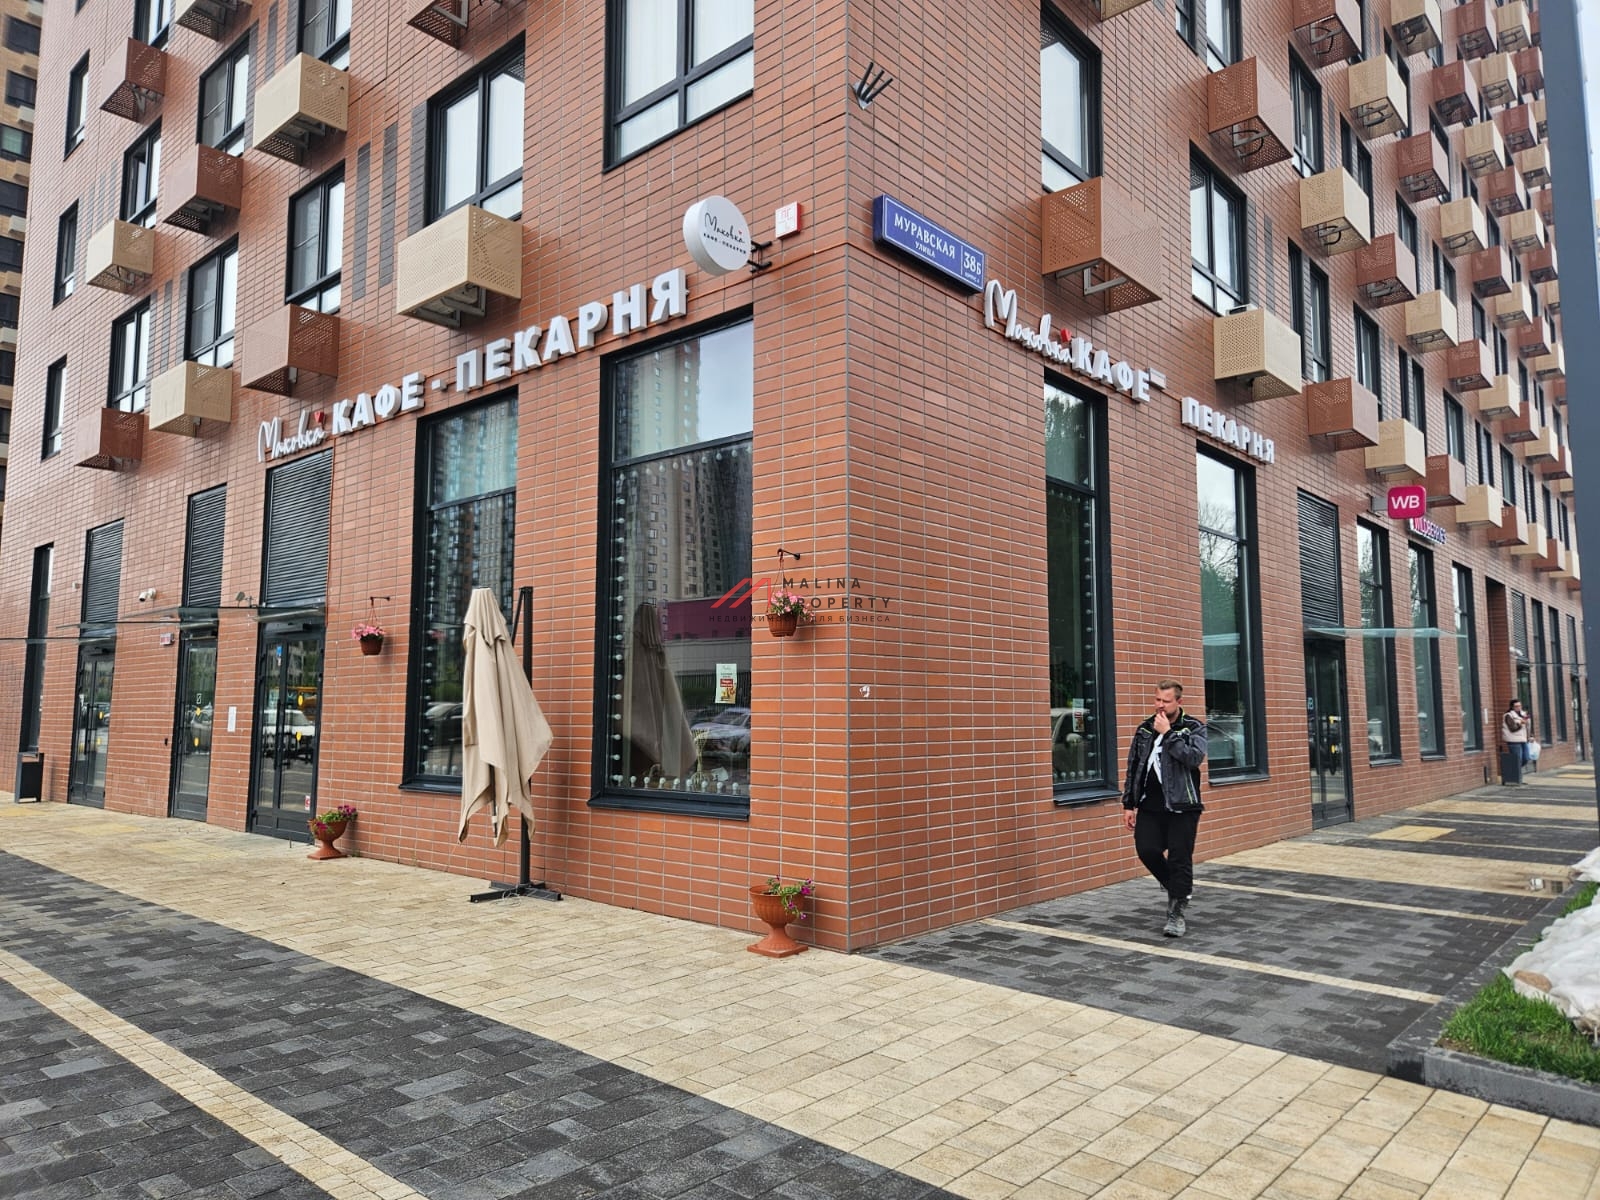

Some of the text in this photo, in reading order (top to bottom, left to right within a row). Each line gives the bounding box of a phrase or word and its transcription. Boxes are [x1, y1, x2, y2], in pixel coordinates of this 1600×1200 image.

[894, 212, 956, 259] МУРАВСКАЯ
[915, 240, 936, 258] УЛИЦА
[963, 251, 982, 275] 38Б
[257, 409, 328, 463] Маковка
[332, 371, 425, 435] КАФЕ
[456, 268, 687, 392] ПЕКАРНЯ
[984, 279, 1275, 465] Маковка КАФЕ ПЕКАРНЯ
[1391, 495, 1420, 509] WB
